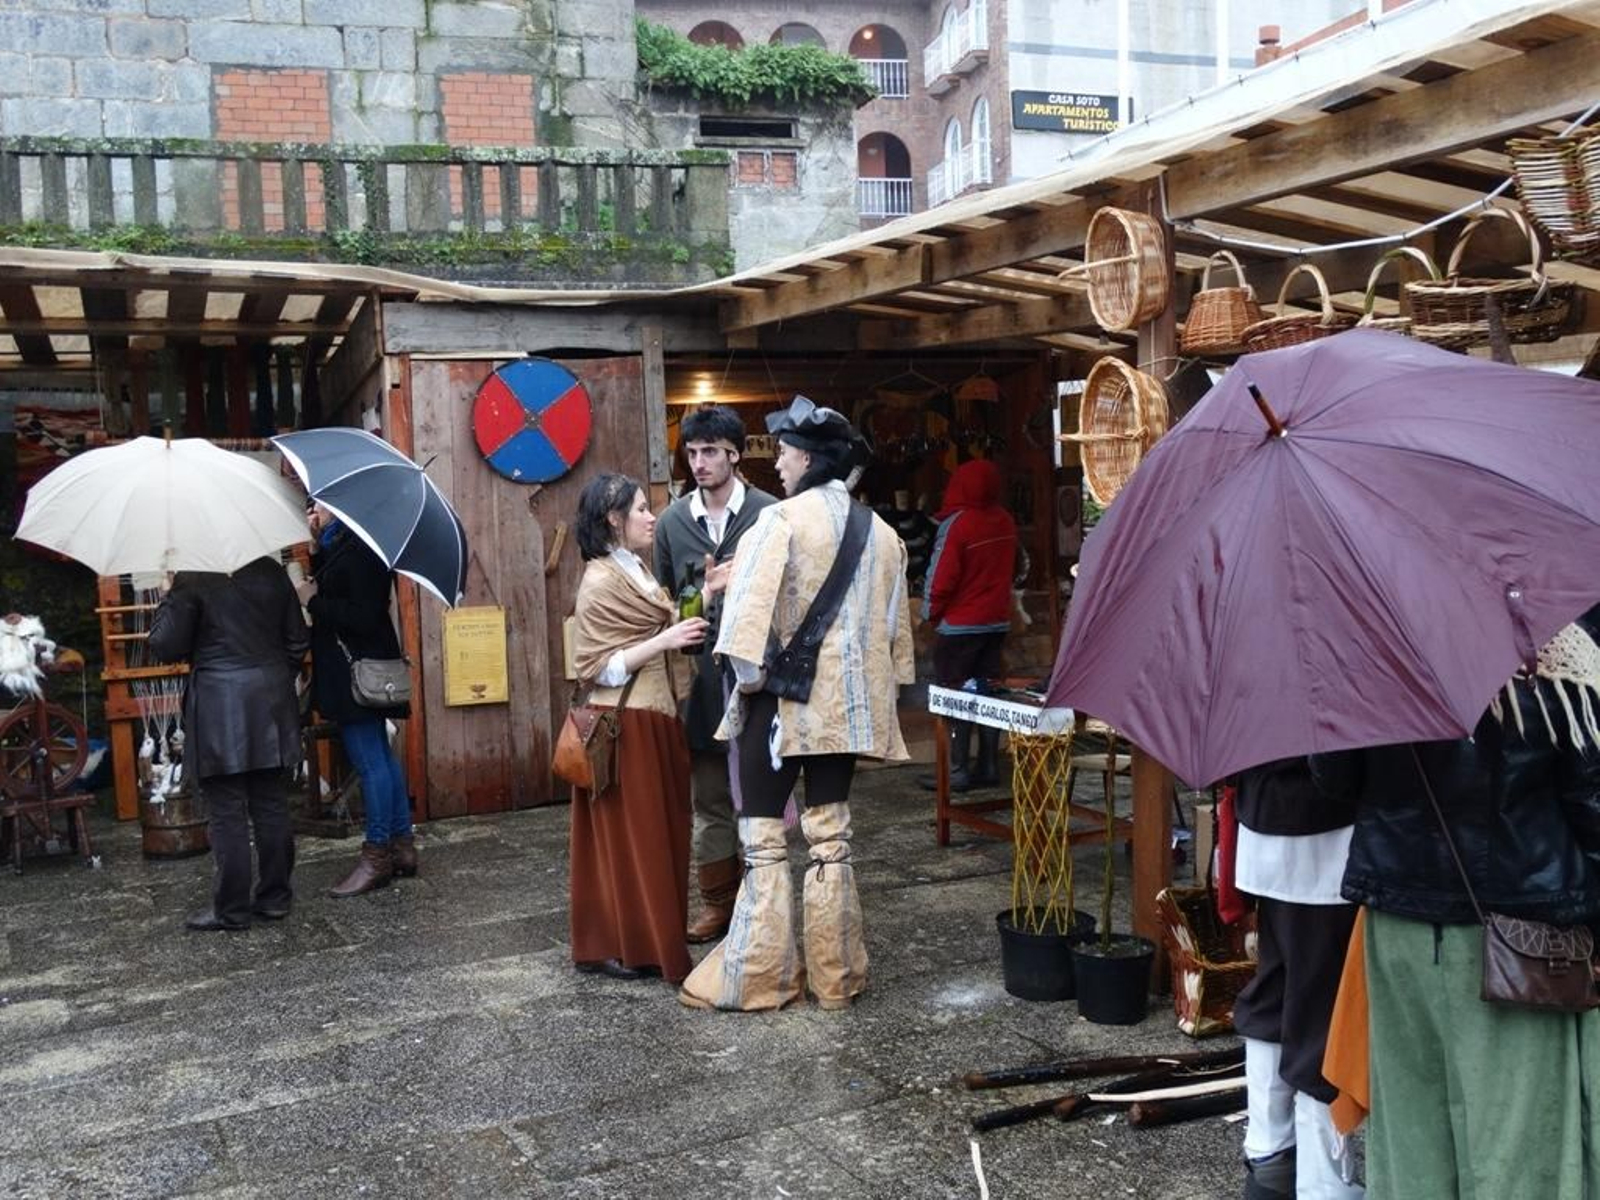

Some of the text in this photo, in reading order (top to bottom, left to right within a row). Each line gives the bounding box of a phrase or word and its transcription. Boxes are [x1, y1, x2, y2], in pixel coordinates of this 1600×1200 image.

[1048, 94, 1100, 106] CASA SOTO
[1023, 103, 1110, 118] APARTAMENTOS
[932, 693, 942, 707] DE
